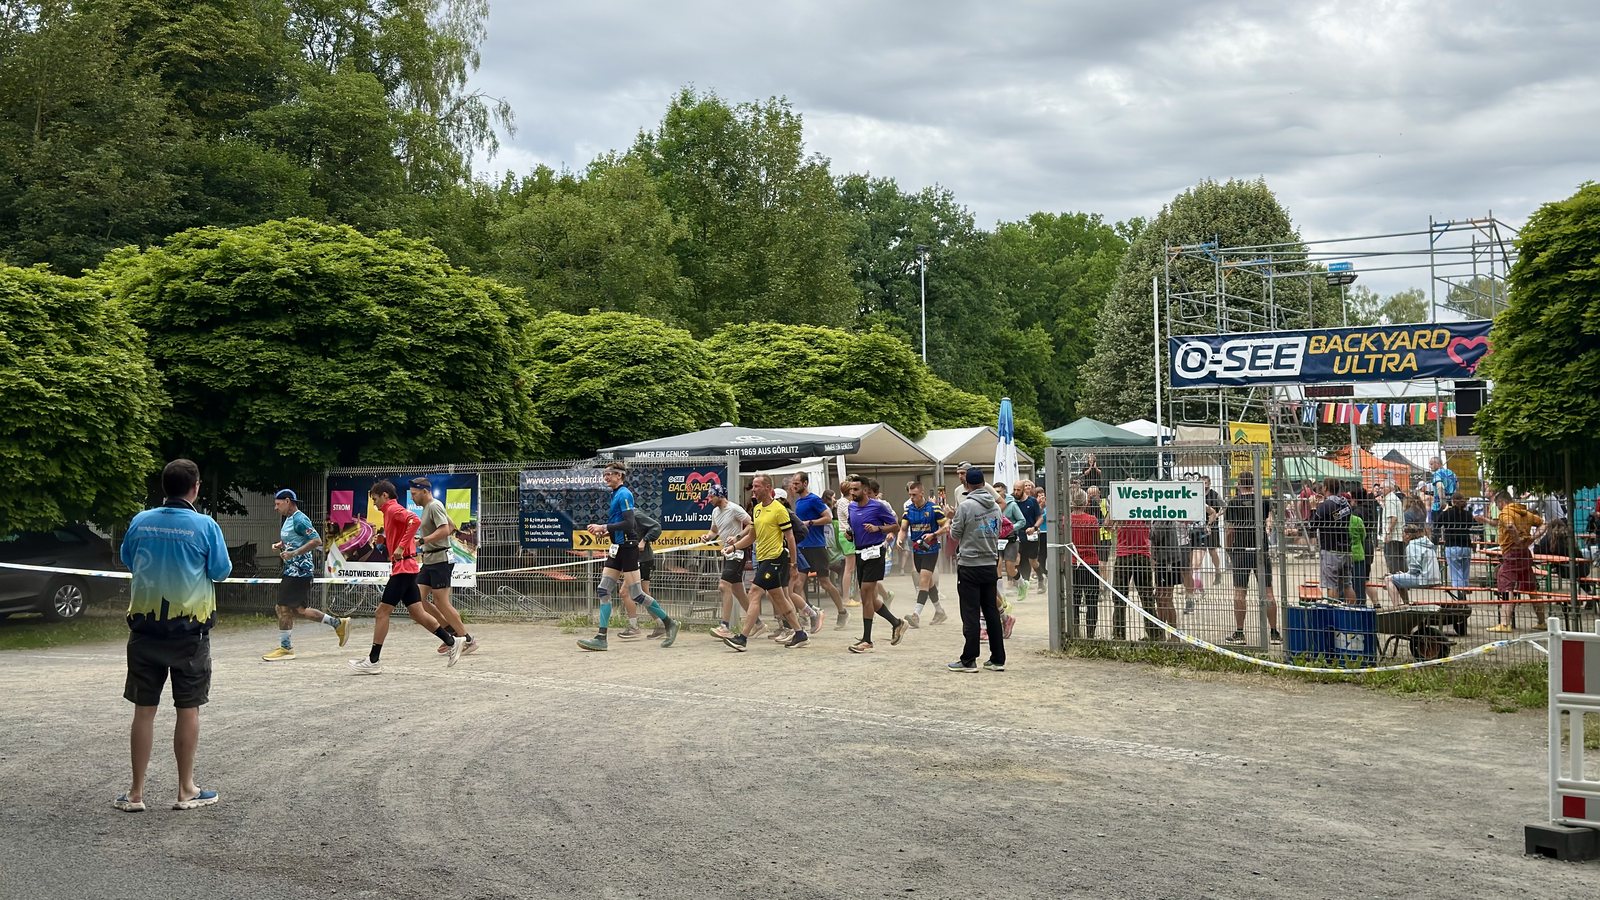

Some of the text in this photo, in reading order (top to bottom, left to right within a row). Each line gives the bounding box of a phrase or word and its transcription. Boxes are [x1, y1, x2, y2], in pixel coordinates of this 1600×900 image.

[1308, 329, 1451, 355] BACKYARD
[1176, 338, 1305, 377] O-SEE
[1333, 352, 1418, 375] ULTRA
[666, 450, 689, 458] GENUSS
[725, 445, 799, 457] SEIT 1869 AUS GÖRLITZ
[668, 483, 712, 492] BACKYARD
[676, 492, 701, 500] ULTRA
[1116, 486, 1198, 502] Westpark-
[664, 514, 684, 522] 11./12.
[685, 512, 698, 521] Juli
[1129, 505, 1187, 519] stadion
[594, 535, 609, 545] Wie
[657, 536, 687, 546] schaffst
[688, 536, 702, 545] du?
[338, 569, 388, 578] STADTWERKE ZIT
